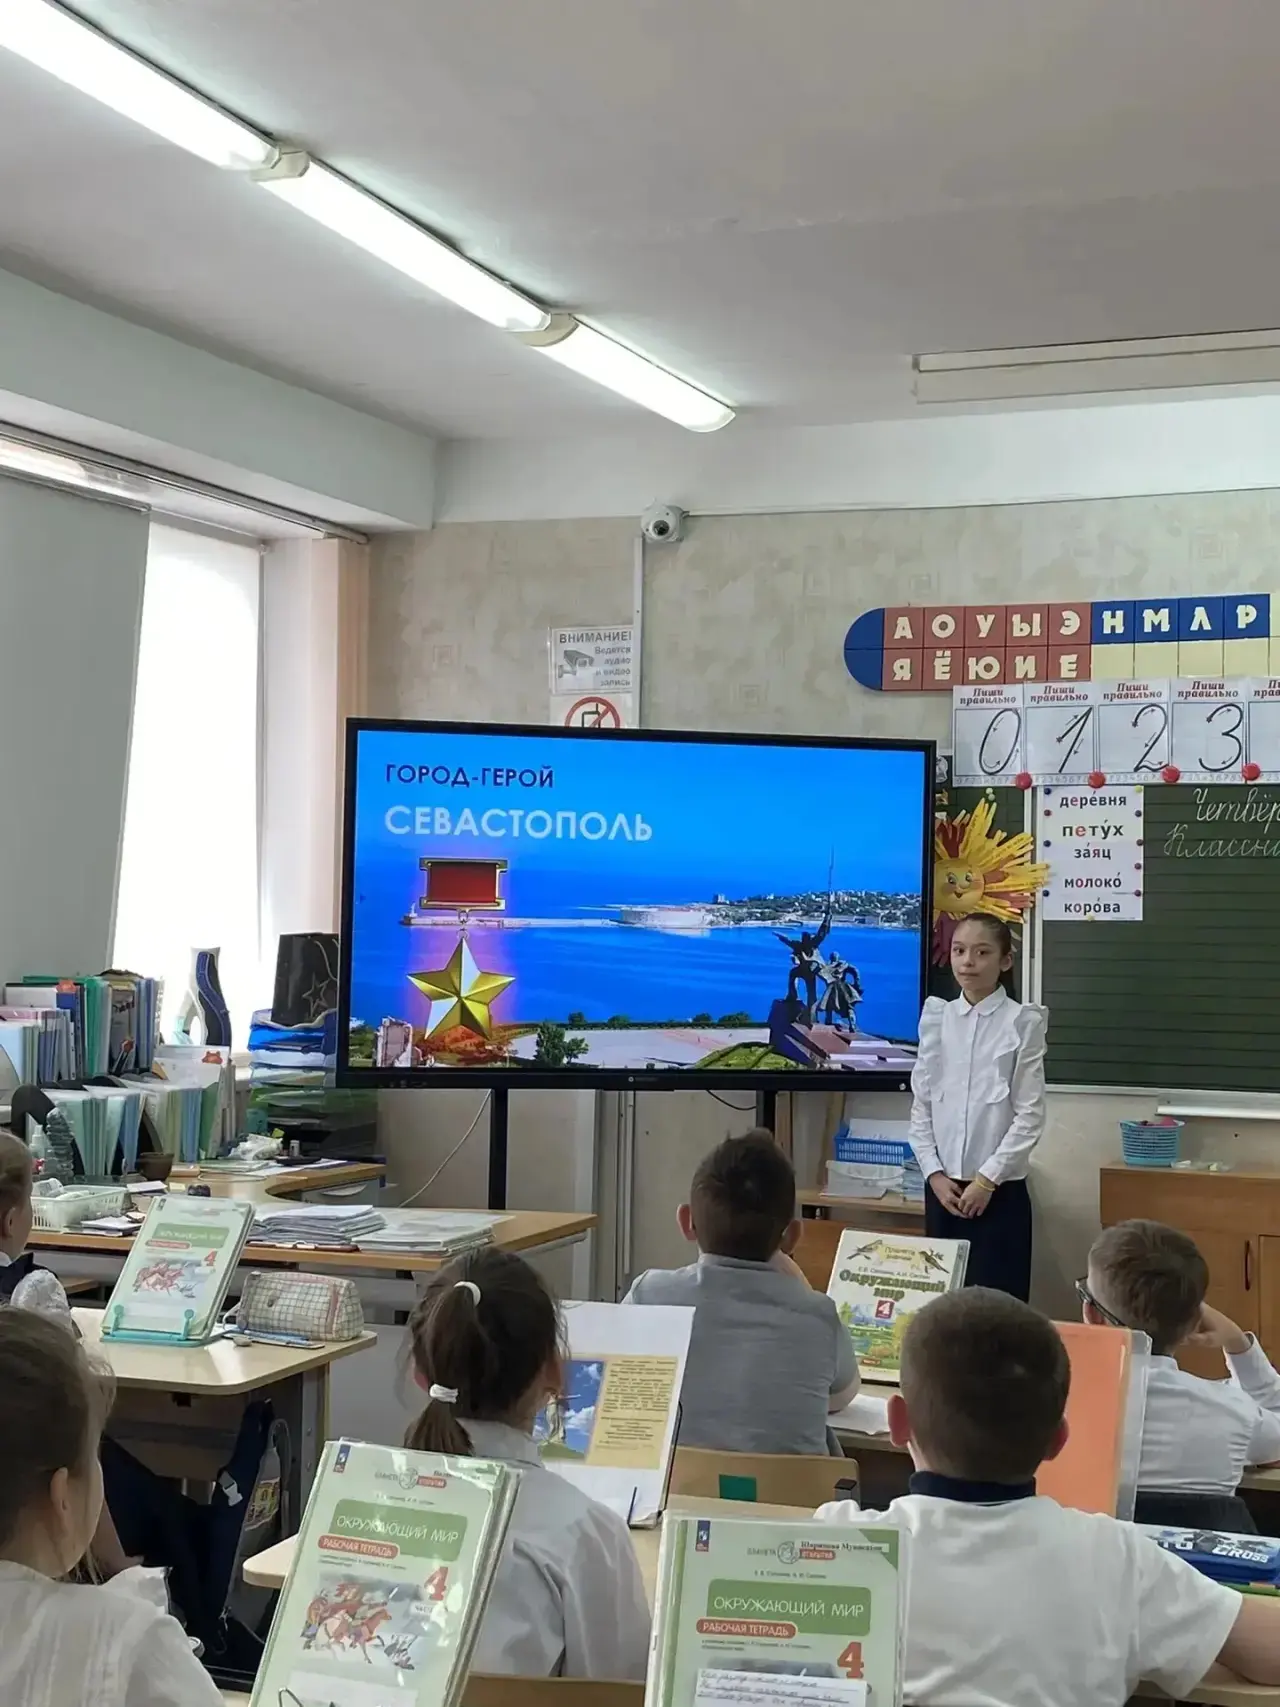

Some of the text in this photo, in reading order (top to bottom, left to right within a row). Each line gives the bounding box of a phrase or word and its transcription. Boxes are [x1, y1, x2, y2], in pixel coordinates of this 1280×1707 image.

[893, 616, 913, 640] А
[931, 613, 956, 638] О
[975, 613, 996, 638] У
[1011, 612, 1042, 638] Ы
[1059, 610, 1081, 635] Э
[1102, 609, 1125, 634] Н
[1142, 607, 1170, 632] М
[1236, 604, 1258, 629] Р
[892, 650, 1079, 680] Я Ё Ю И Е
[973, 687, 1004, 697] Пиши
[1043, 685, 1075, 695] Пиши
[1116, 682, 1149, 692] Пиши
[1177, 689, 1239, 700] правильно
[1191, 681, 1225, 690] Пиши
[960, 695, 1017, 706] правильно
[1030, 692, 1089, 703] правильно
[1103, 690, 1163, 702] правильно
[979, 708, 1022, 776] 0
[1055, 706, 1093, 774] 1
[1131, 703, 1170, 773] 2
[1198, 703, 1244, 772] 3
[385, 763, 554, 788] ГОРОД-ГЕРОЙ
[384, 804, 653, 842] СЕВАСТОПОЛЬ
[204, 1248, 218, 1266] 4
[878, 1302, 892, 1315] 4
[430, 1529, 459, 1544] МИР
[1212, 1544, 1270, 1563] CROSS
[423, 1566, 449, 1601] 4
[713, 1596, 864, 1616] ОКРУЖАЮЩИЙ МИР
[702, 1622, 790, 1637] РАБОЧАЯ ТЕТРАДЬ
[837, 1641, 865, 1679] 4
